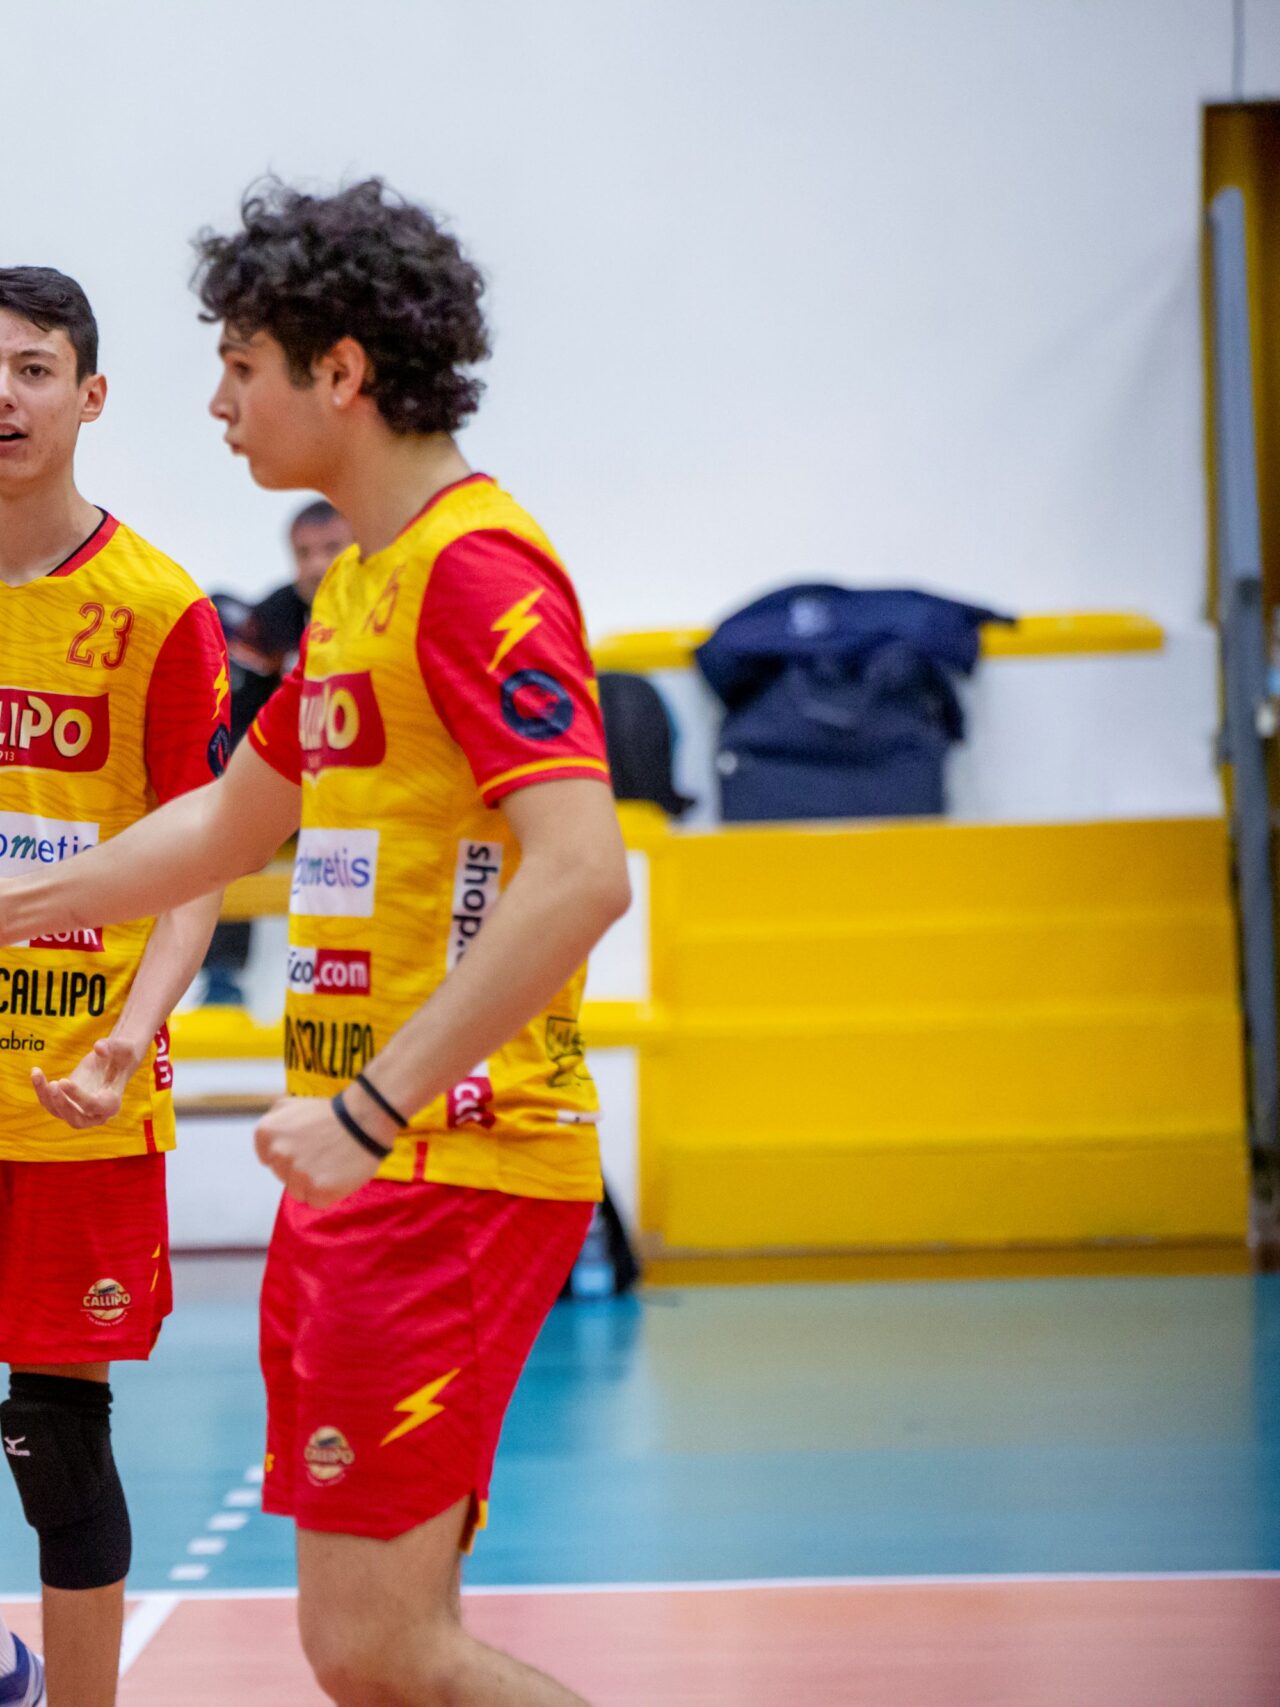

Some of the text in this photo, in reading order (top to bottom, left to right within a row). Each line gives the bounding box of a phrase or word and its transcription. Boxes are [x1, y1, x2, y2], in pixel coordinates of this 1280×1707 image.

[66, 602, 135, 671] 23
[452, 844, 498, 962] shop.
[83, 1293, 131, 1307] CALLIPO
